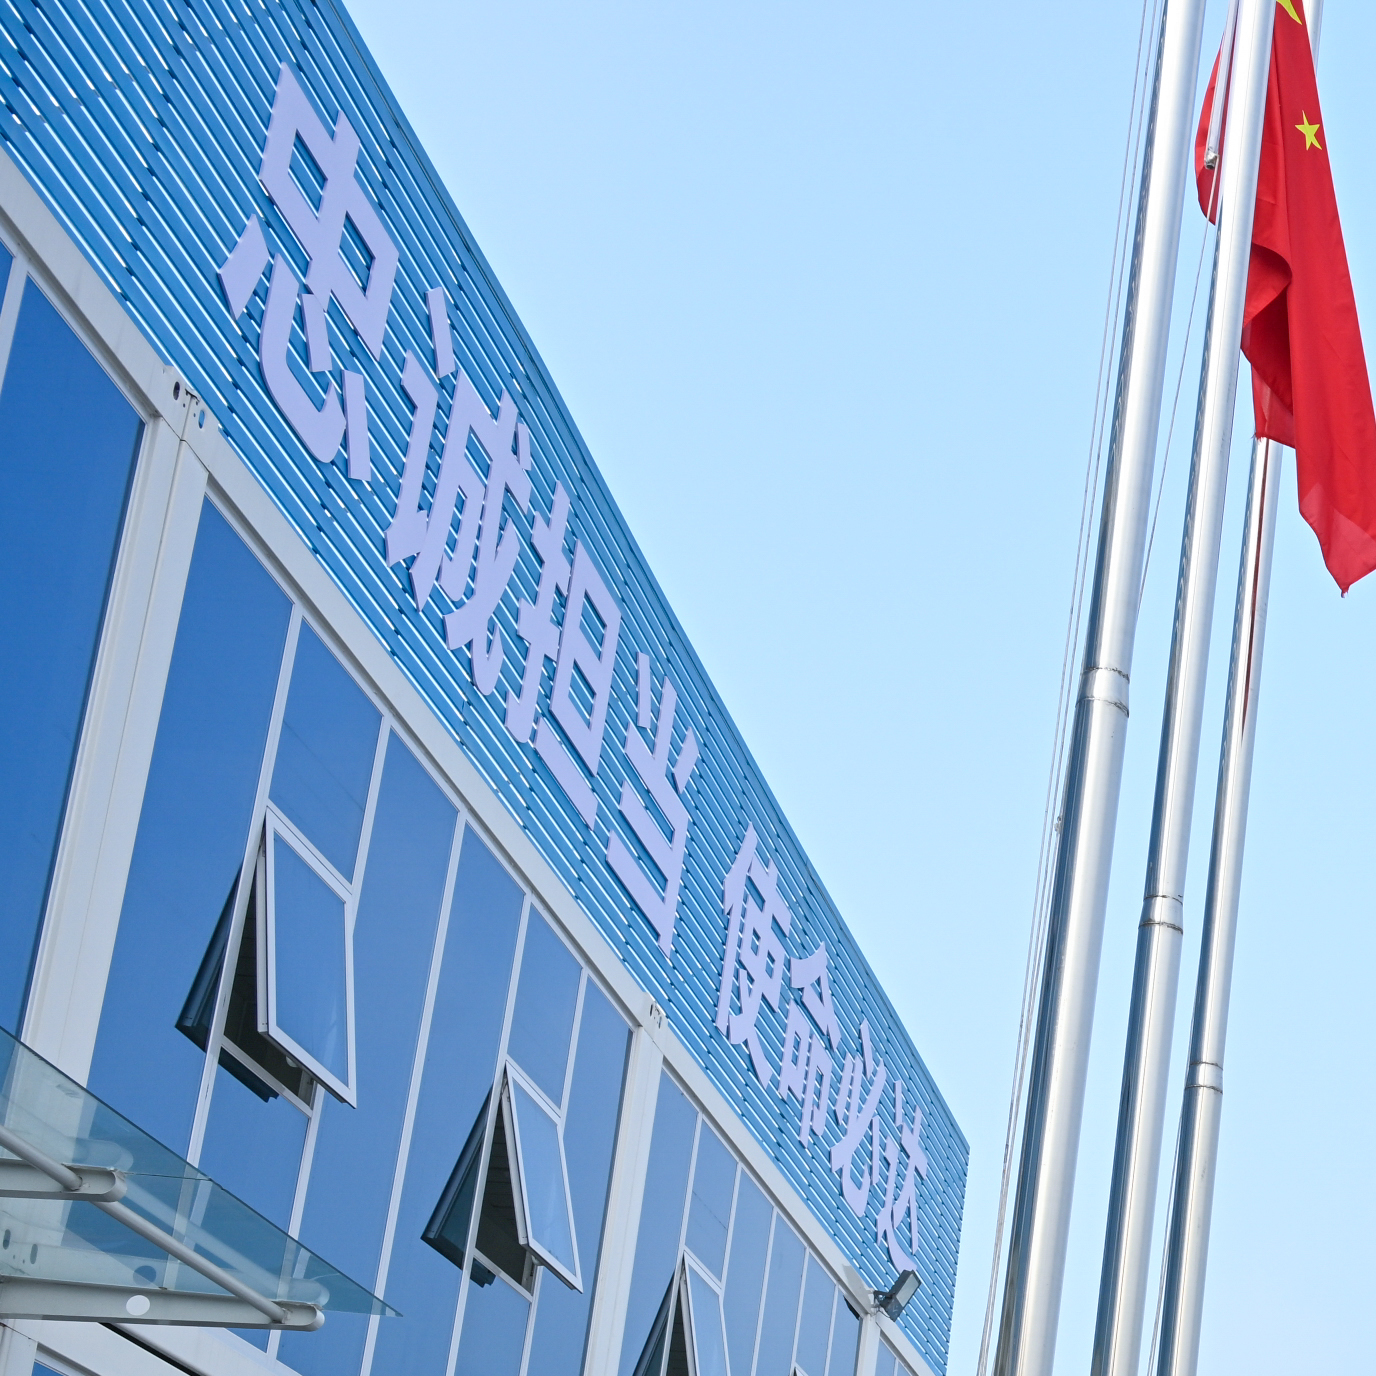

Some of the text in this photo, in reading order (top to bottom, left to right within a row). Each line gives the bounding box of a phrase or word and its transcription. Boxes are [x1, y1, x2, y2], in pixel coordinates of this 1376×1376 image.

[220, 63, 928, 1272] 忠诚担当 使命必达
